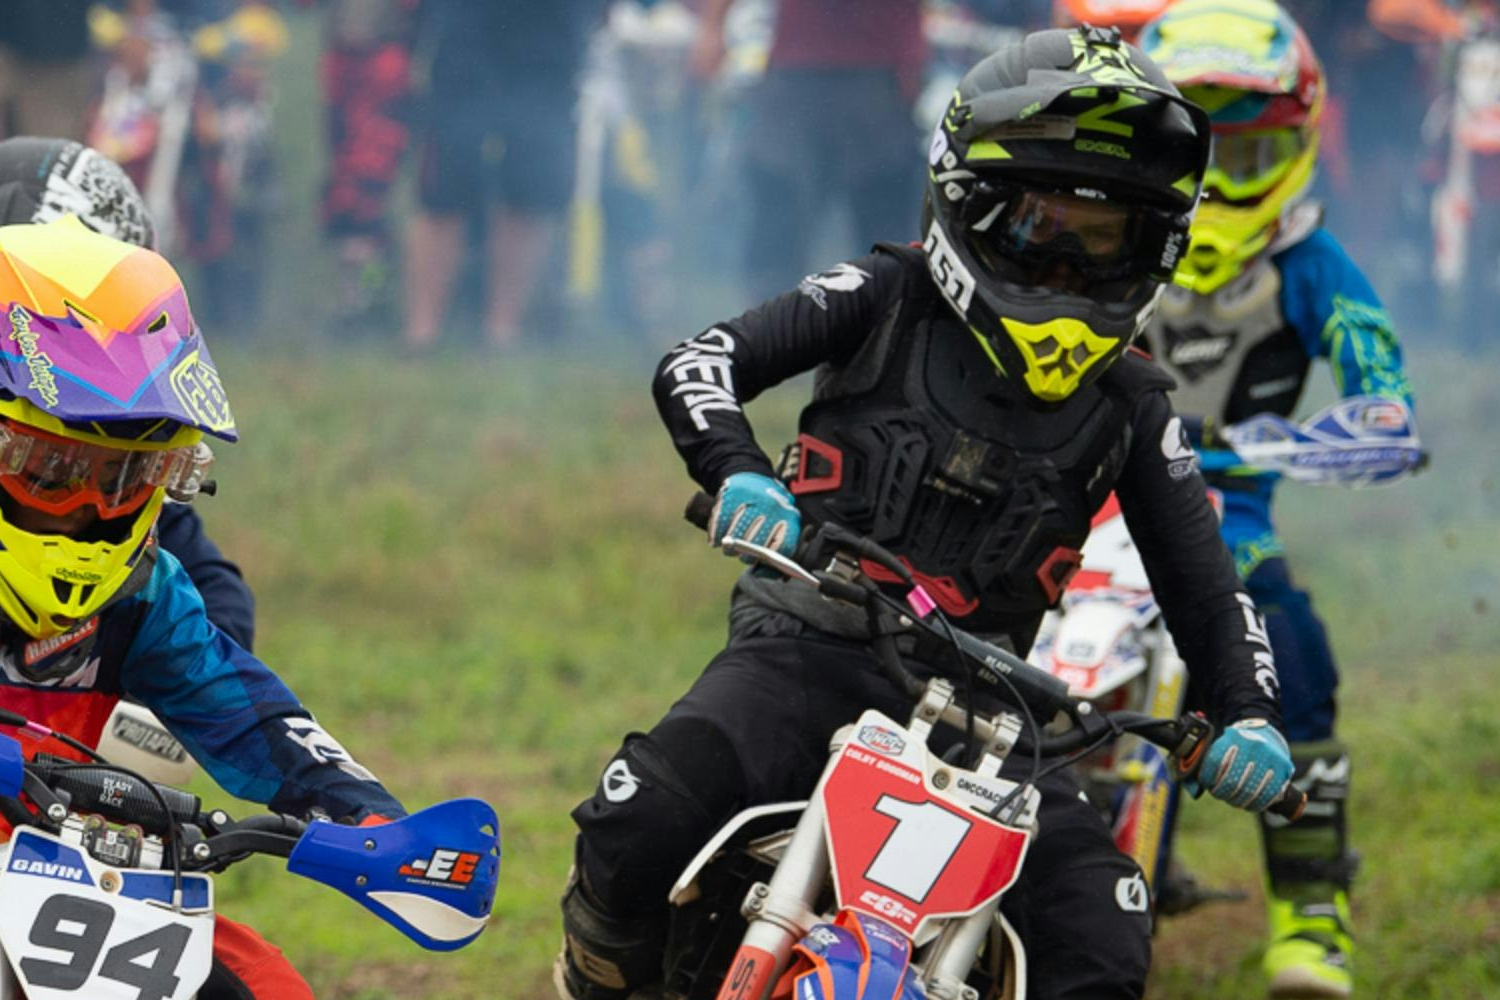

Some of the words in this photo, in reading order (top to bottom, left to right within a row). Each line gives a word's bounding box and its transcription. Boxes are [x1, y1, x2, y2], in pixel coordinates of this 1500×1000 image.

[103, 777, 133, 794] READY
[863, 793, 974, 906] 1
[11, 859, 84, 881] GAVIN
